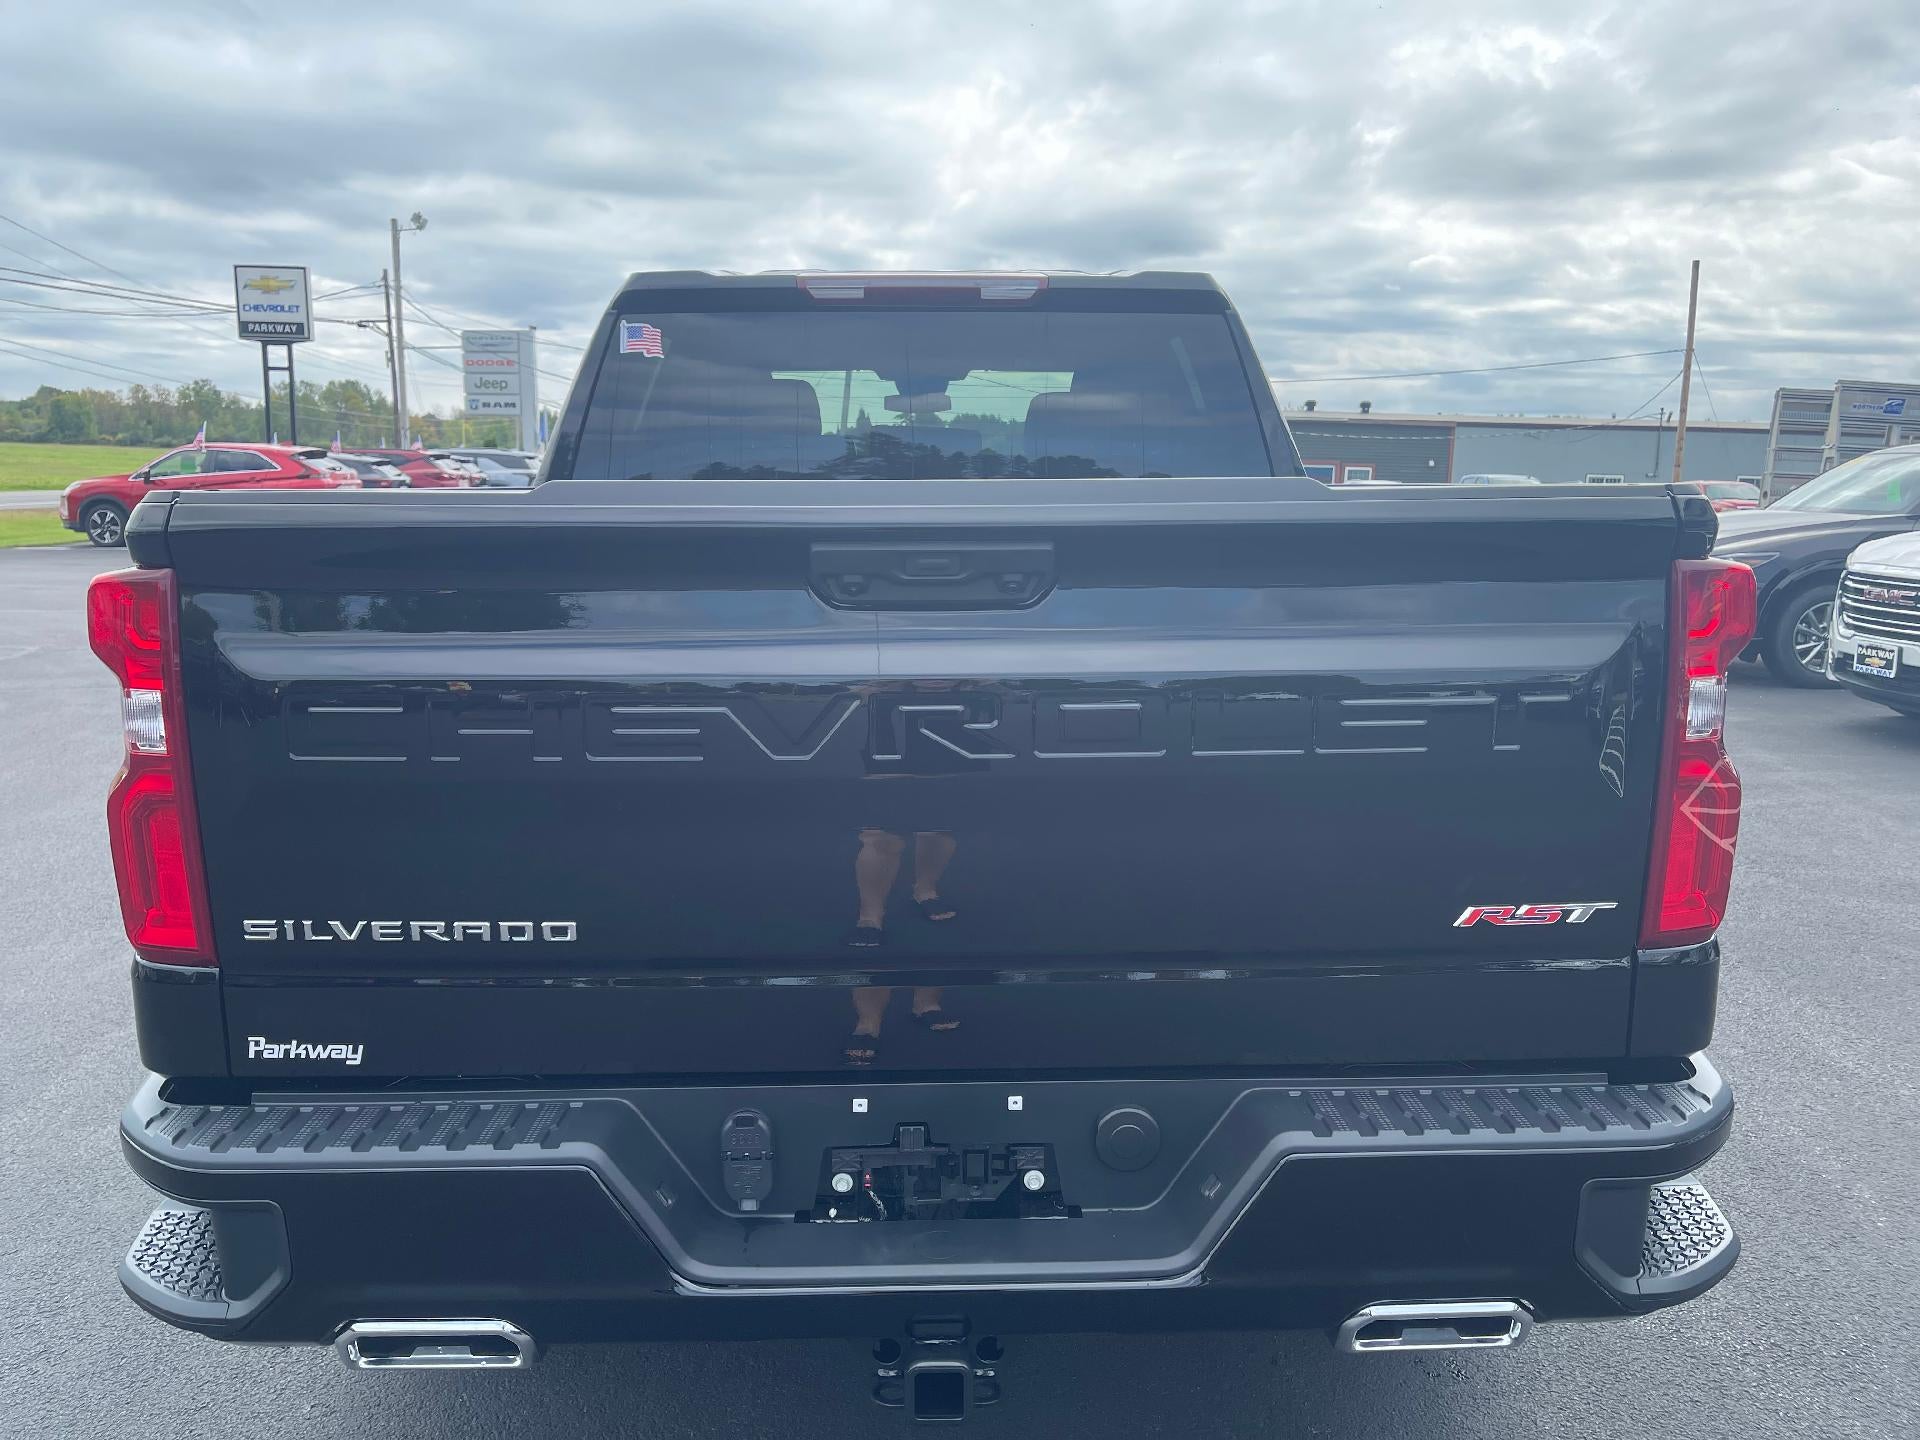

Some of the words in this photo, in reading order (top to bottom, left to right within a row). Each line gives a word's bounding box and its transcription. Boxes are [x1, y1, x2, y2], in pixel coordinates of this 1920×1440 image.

[243, 304, 299, 313] CHEVROLET
[248, 323, 297, 333] PARKWAY
[465, 359, 515, 368] DODGE
[474, 377, 508, 391] Jeep
[1864, 587, 1918, 606] GMC
[1858, 646, 1896, 660] PARKWAY
[284, 691, 1572, 764] CHEVROLET
[1453, 902, 1619, 928] RST
[243, 919, 577, 941] SILVERADO
[248, 1036, 363, 1064] Parkway
